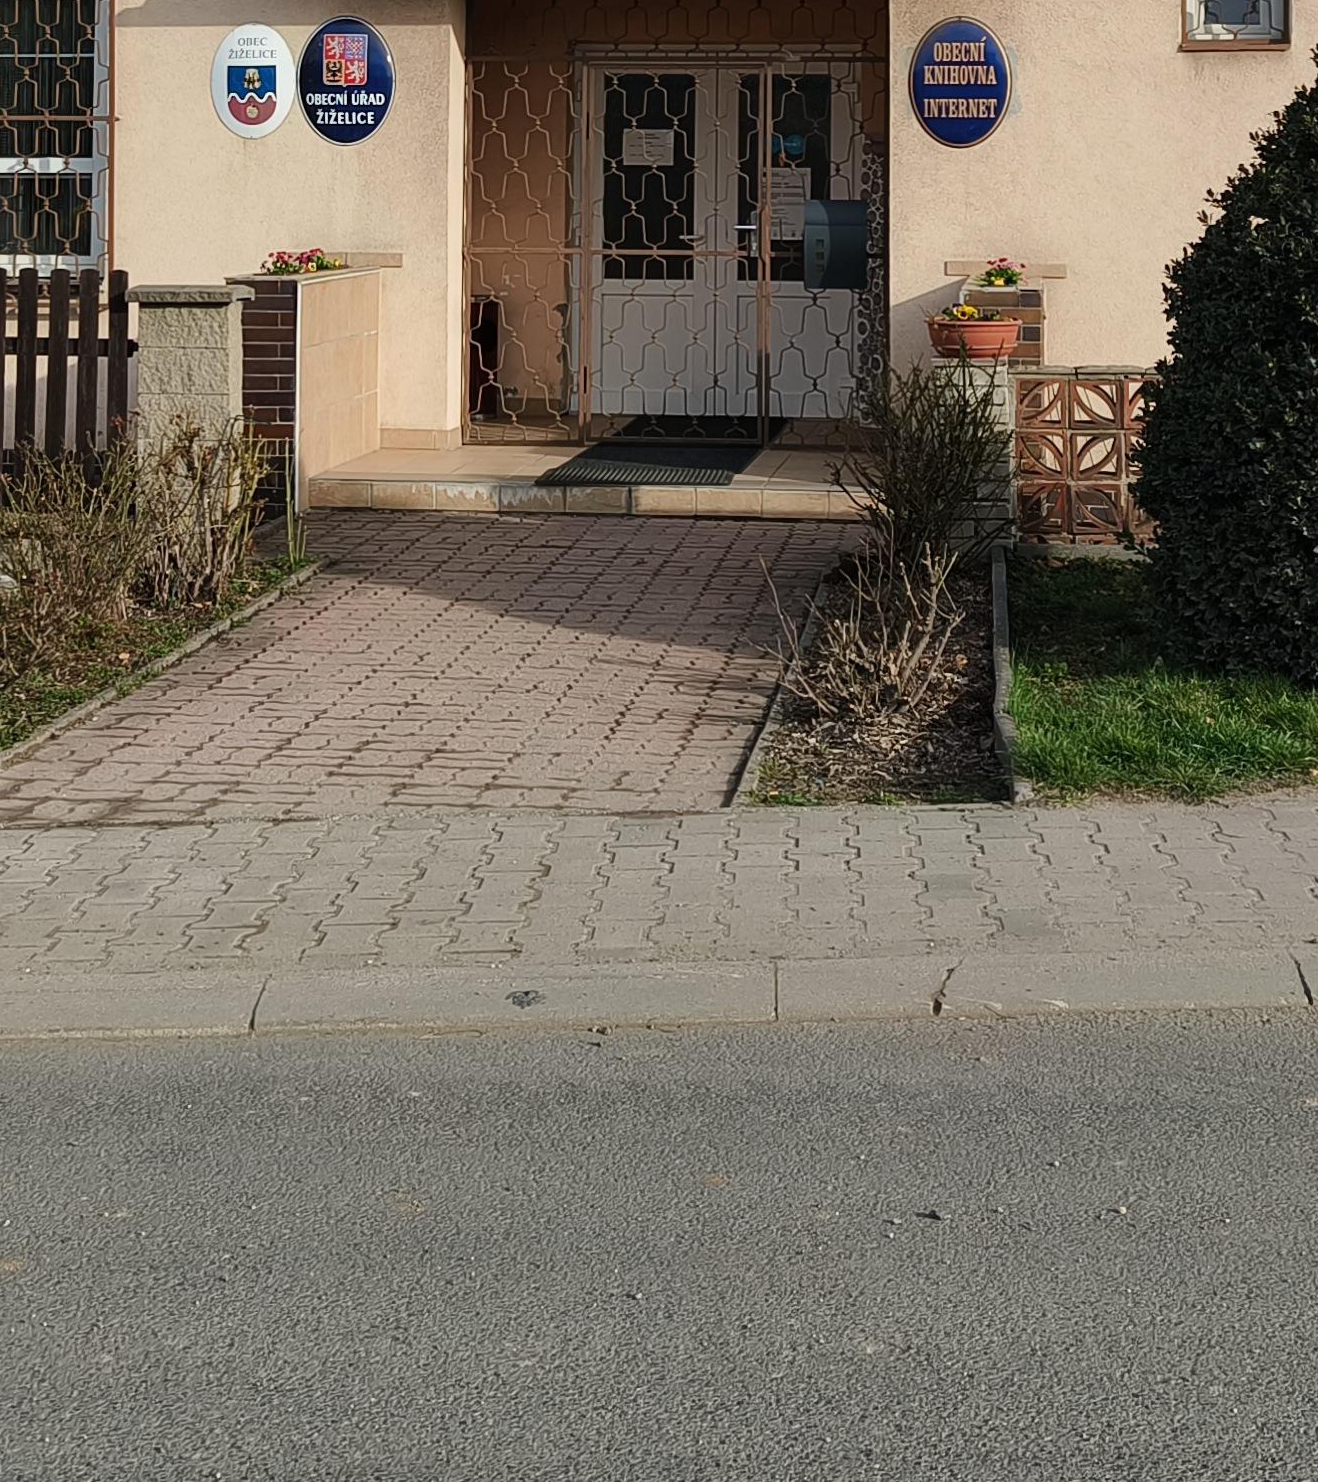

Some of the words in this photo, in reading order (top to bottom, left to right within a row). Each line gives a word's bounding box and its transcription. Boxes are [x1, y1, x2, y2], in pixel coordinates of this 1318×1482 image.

[237, 37, 268, 47] OBEC
[933, 36, 986, 62] OBECNÍ
[228, 48, 277, 59] ŽIŽELICE
[923, 65, 997, 85] KNIHOVNA
[306, 90, 347, 106] OBECNÍ
[351, 89, 385, 106] ÚŘAD
[923, 98, 997, 118] INTERNET
[316, 109, 375, 125] ŽIŽELICE
